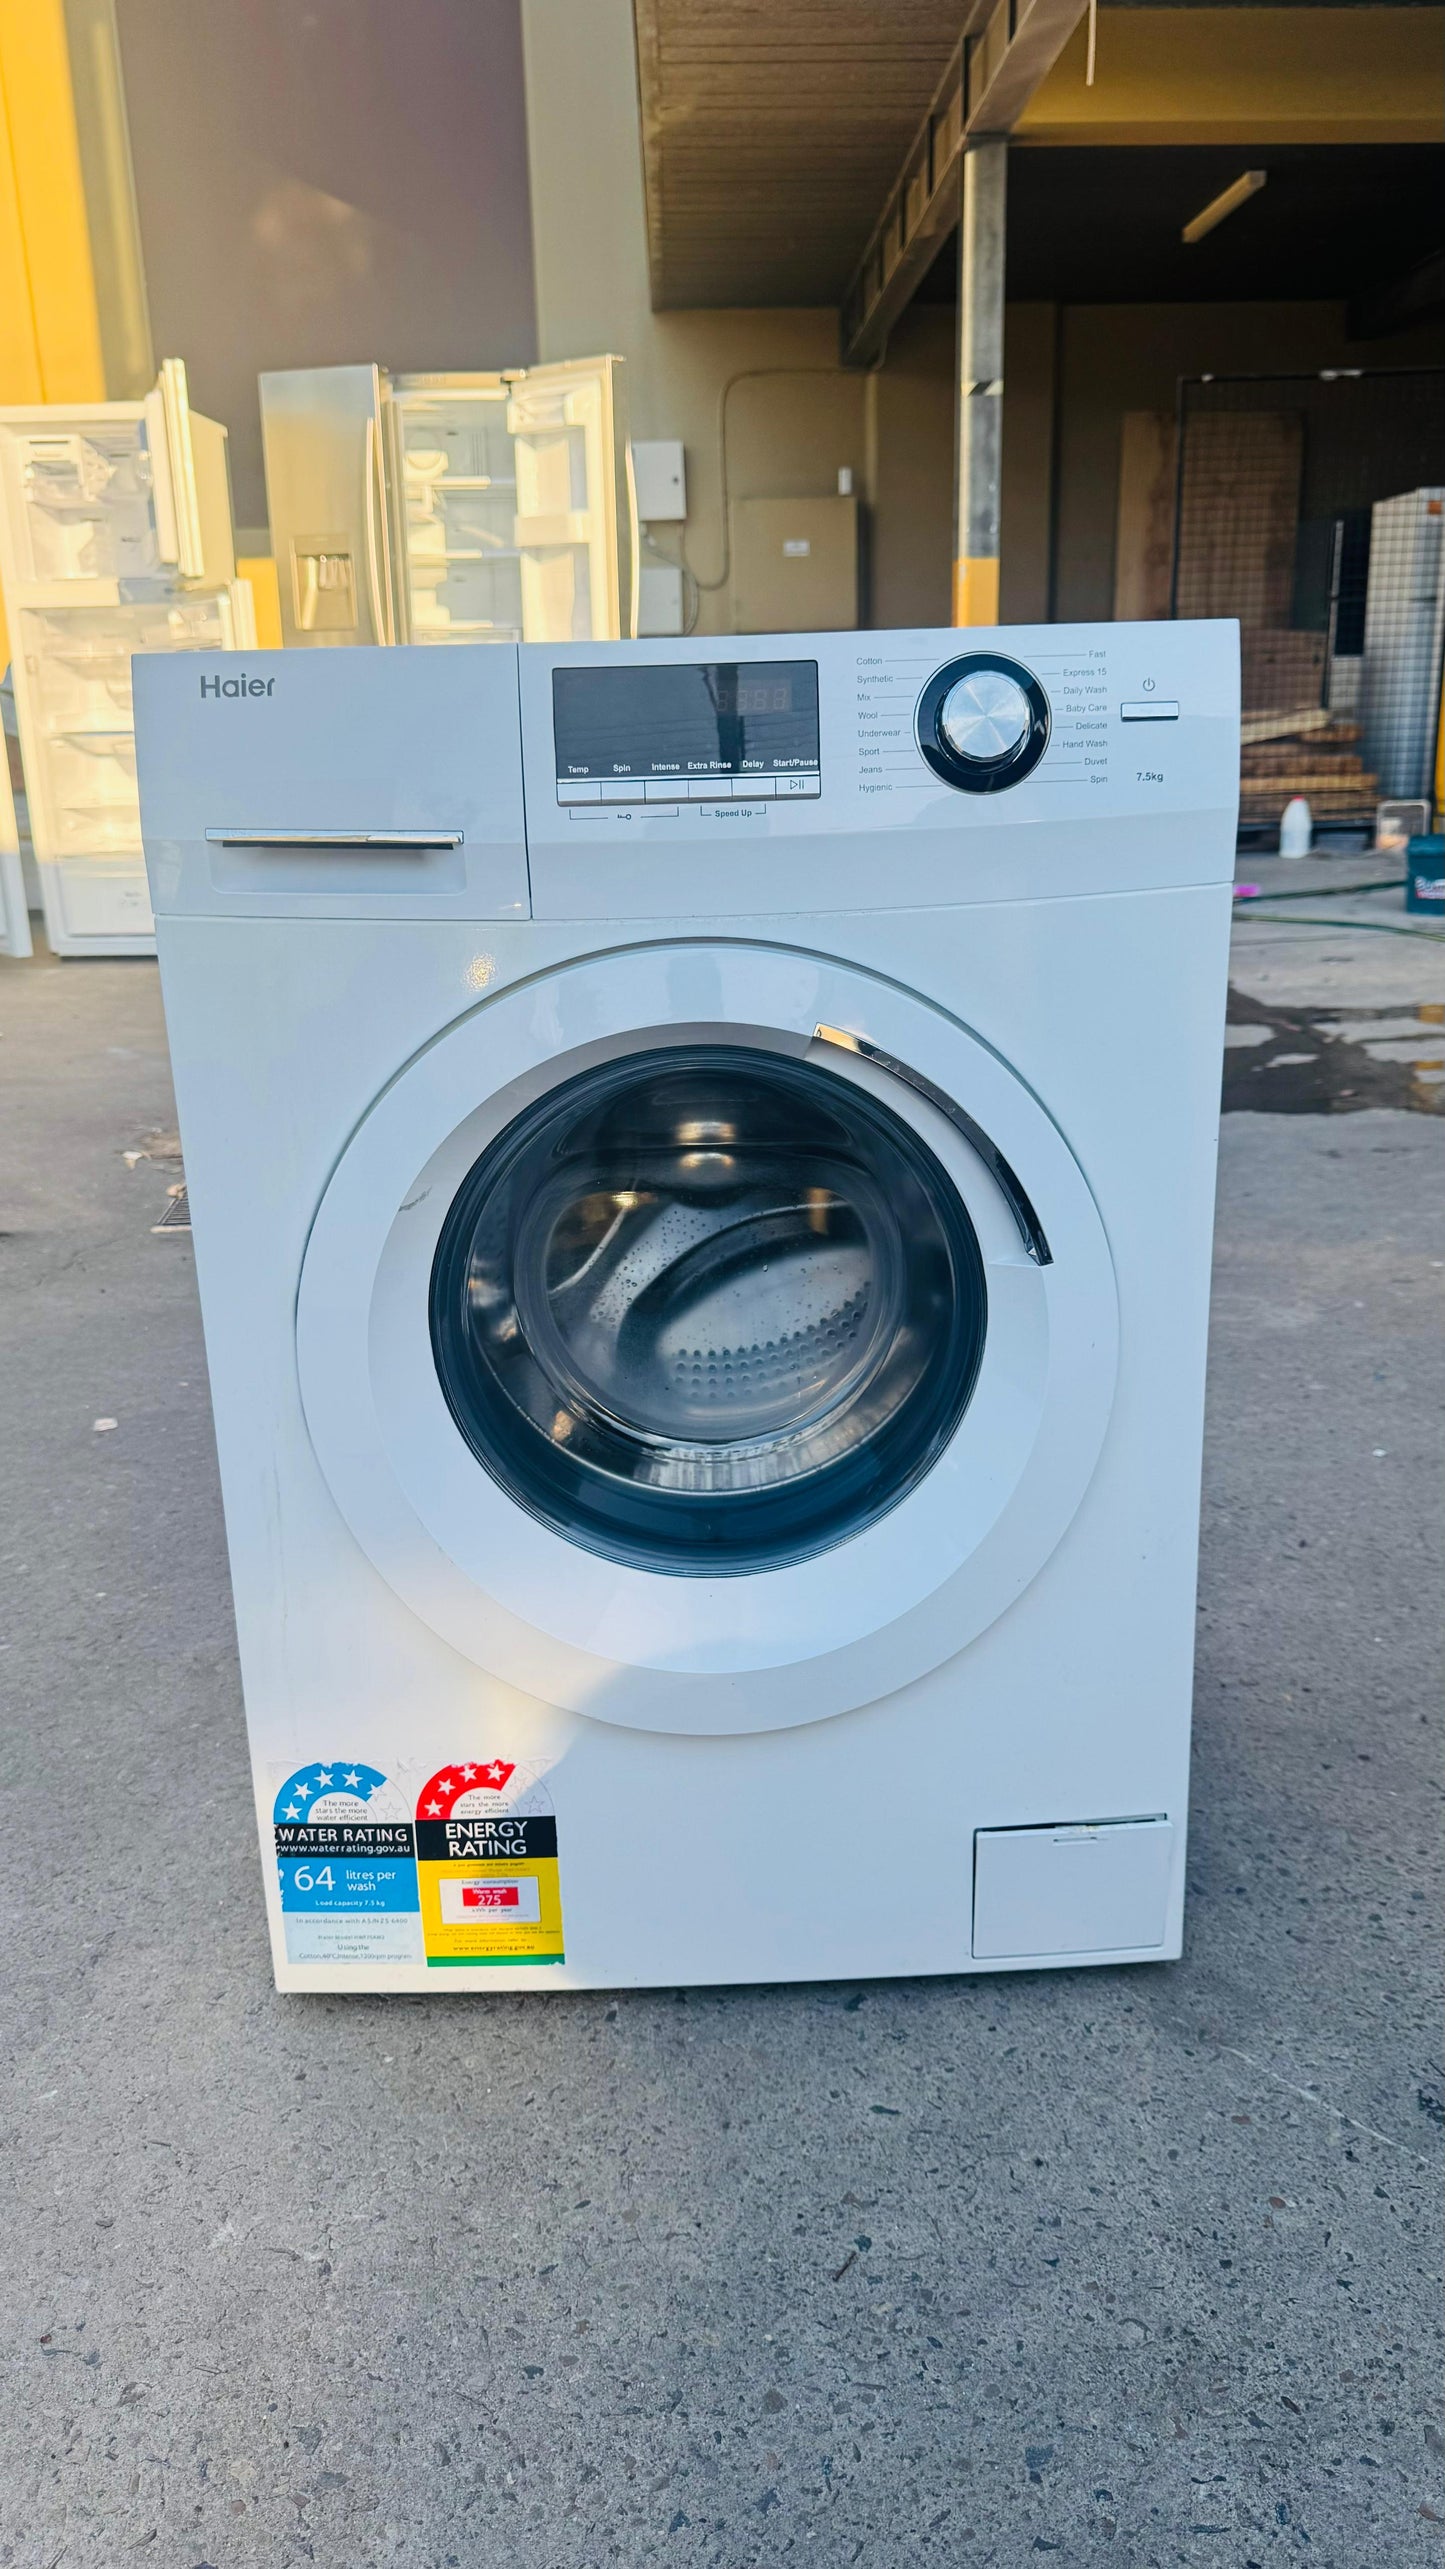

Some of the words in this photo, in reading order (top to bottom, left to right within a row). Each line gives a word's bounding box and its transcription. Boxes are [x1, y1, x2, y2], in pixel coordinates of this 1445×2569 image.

[1088, 650, 1106, 658] Fast
[856, 656, 883, 665] Cotton
[1063, 669, 1095, 679] Express
[1098, 667, 1107, 676] 15
[857, 674, 894, 685] Synthetic
[200, 673, 276, 699] Haier
[1063, 687, 1083, 695] Daily
[1085, 686, 1108, 694] Wash
[857, 693, 871, 702] Mix
[1066, 705, 1086, 714] Baby
[1088, 703, 1107, 712] Care
[858, 711, 879, 720] Wool
[1076, 722, 1108, 730] Delicate
[857, 729, 901, 738] Underwear
[1063, 740, 1084, 749] Hand
[1086, 739, 1108, 748] Wash
[858, 747, 880, 757] Sport
[687, 761, 708, 771] Extra
[709, 760, 732, 770] Rinse
[742, 759, 764, 770] Delay
[772, 758, 818, 768] Start/Pause
[1084, 757, 1108, 766] Duvet
[568, 765, 590, 775] Temp
[613, 763, 632, 773] Spin
[651, 762, 681, 772] Intense
[858, 765, 883, 774] Jeans
[1090, 775, 1108, 785] Spin
[1136, 771, 1164, 783] 7.5kg
[859, 783, 893, 794] Hygienic
[714, 808, 740, 819] Speed
[741, 808, 752, 819] Up
[279, 1828, 338, 1842] WATER
[343, 1828, 408, 1842] RATING
[445, 1821, 528, 1840] ENERGY
[280, 1843, 411, 1855] www.waterrating.gov.au
[448, 1839, 528, 1858] RATING
[294, 1865, 336, 1892] 64
[345, 1869, 375, 1880] litres
[377, 1871, 397, 1882] per
[347, 1880, 377, 1892] wash
[334, 1899, 363, 1907] capacity
[376, 1899, 386, 1907] kg
[477, 1894, 502, 1906] 275
